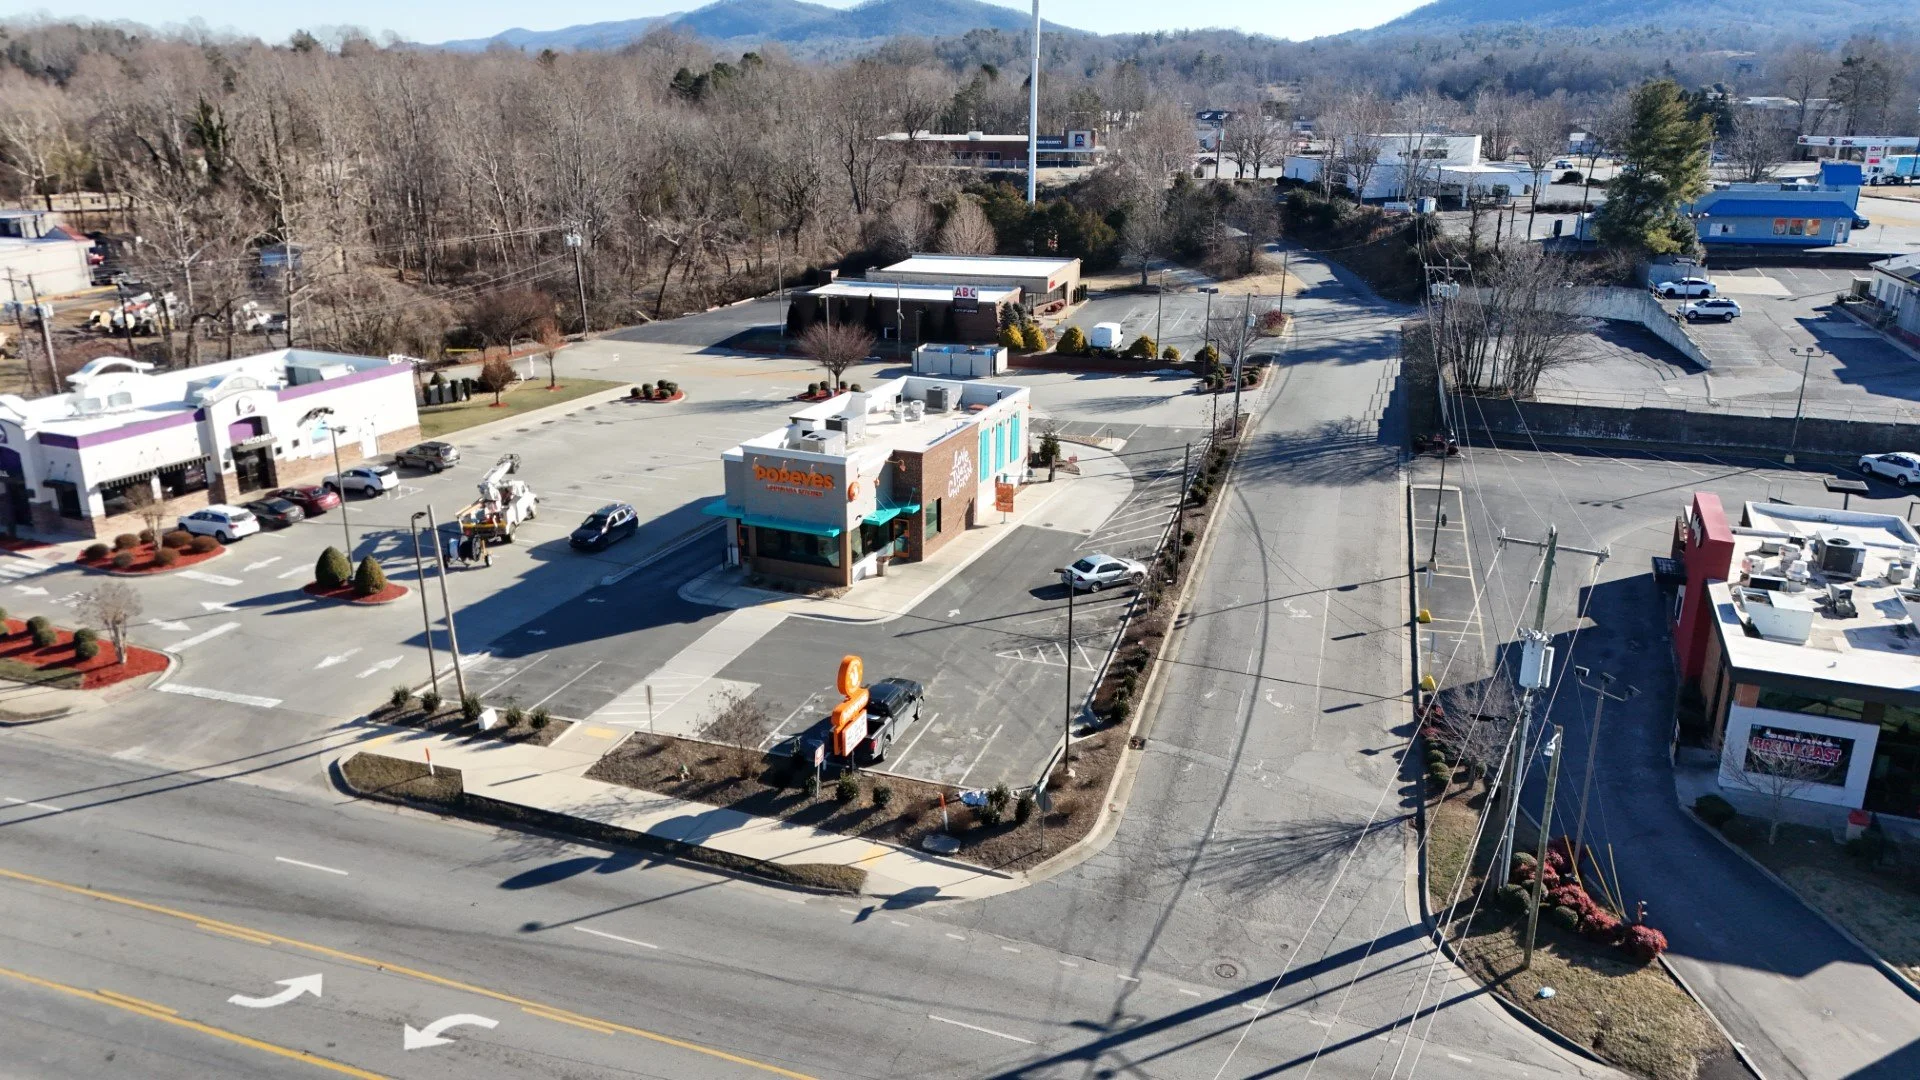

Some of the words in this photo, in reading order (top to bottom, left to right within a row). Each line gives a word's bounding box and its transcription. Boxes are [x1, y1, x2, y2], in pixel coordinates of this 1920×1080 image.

[954, 286, 976, 298] ABC
[242, 436, 261, 446] TACO
[1752, 736, 1842, 763] BREAKFAST
